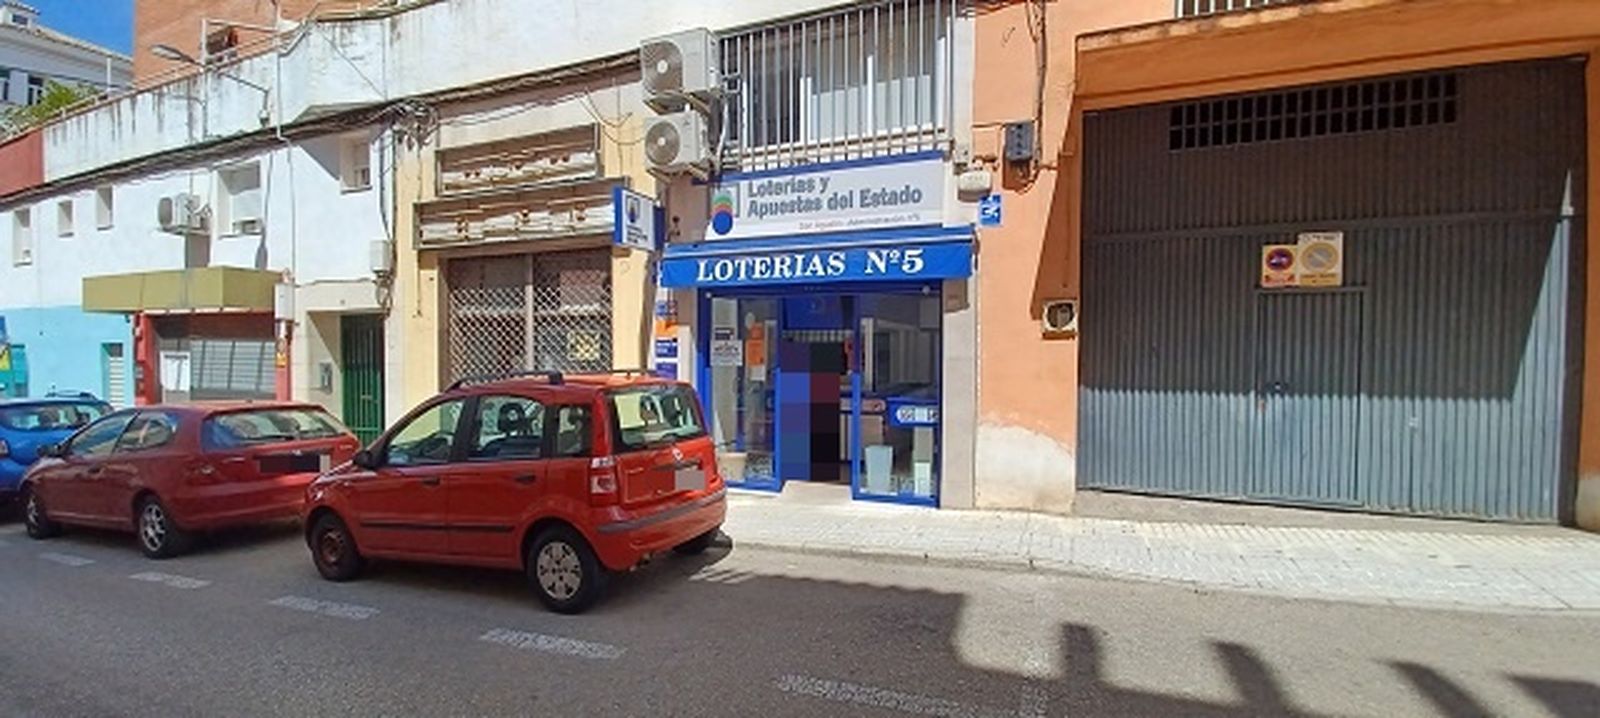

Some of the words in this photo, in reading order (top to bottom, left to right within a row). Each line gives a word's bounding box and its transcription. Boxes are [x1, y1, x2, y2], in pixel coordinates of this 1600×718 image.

[819, 177, 830, 193] y
[748, 195, 822, 219] Apuestas
[827, 190, 853, 211] del
[860, 185, 923, 207] Estado
[697, 252, 846, 281] LOTERIAS
